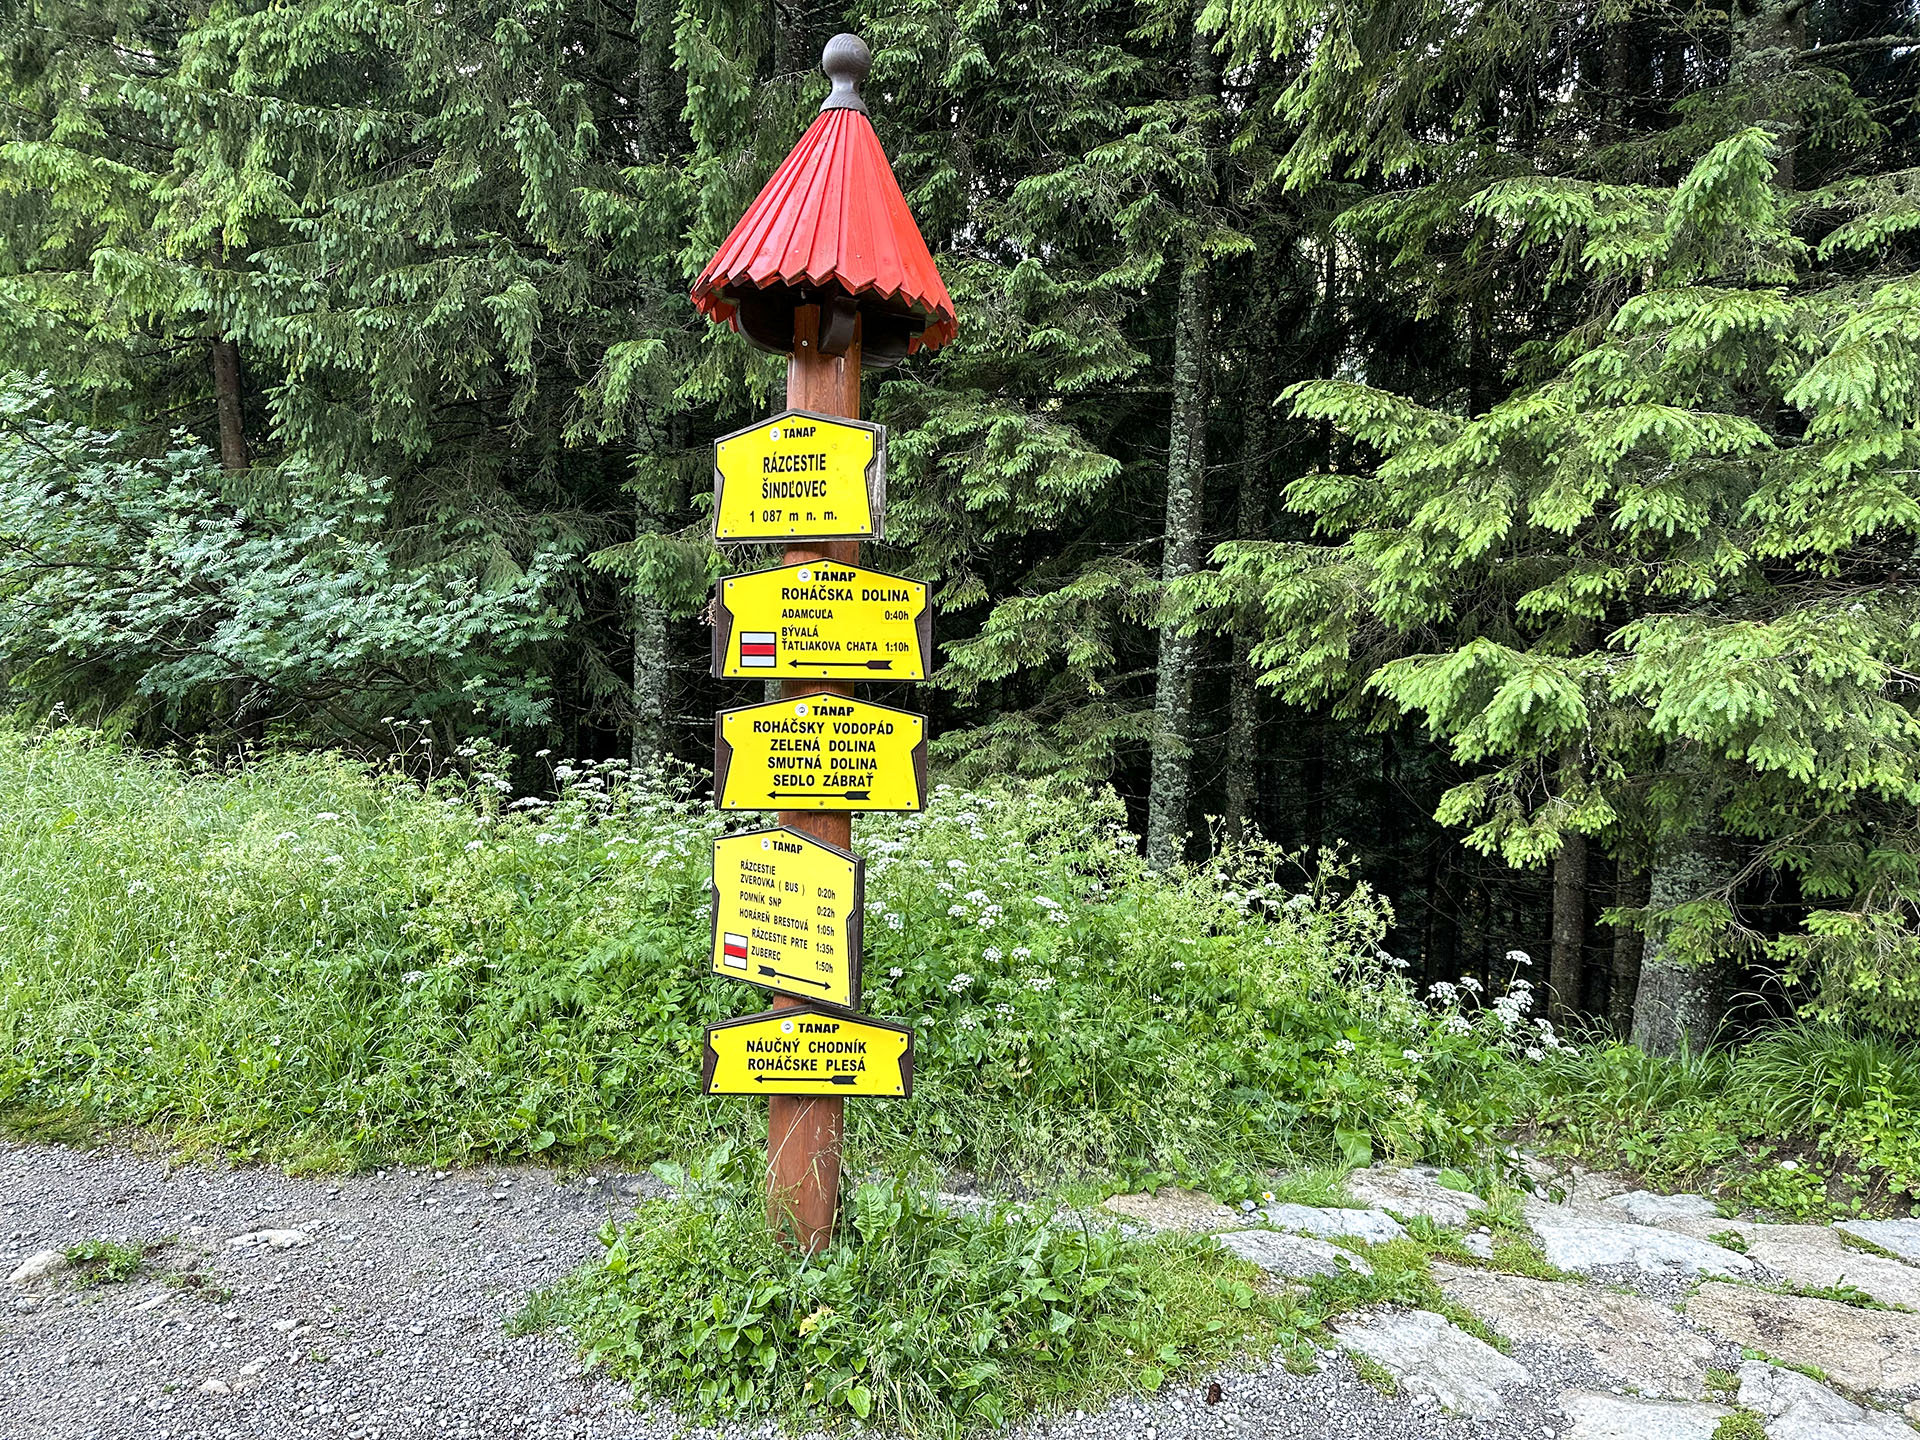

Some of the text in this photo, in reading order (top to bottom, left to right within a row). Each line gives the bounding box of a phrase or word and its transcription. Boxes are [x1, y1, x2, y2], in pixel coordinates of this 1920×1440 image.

[783, 427, 816, 439] TANAP
[763, 451, 826, 473] RÁZCESTIE
[762, 478, 826, 499] ŠINDĽOVEC
[750, 510, 837, 522] 1 087 m n. m.
[814, 571, 856, 582] TANAP
[782, 585, 910, 602] ROHÁČSKA DOLINA
[782, 609, 909, 620] ADAMCUĽA 0:40h
[782, 625, 819, 637] BÝVALÁ
[782, 638, 909, 652] ŤATLIAKOVA CHATA 1:10h
[813, 706, 854, 716] TANAP
[754, 718, 893, 735] ROHÁČSKY VODOPÁD
[770, 737, 876, 752] ZELENÁ DOLINA
[768, 754, 877, 770] SMUTNÁ DOLINA
[773, 772, 874, 787] SEDLO ZÁBRAŤ
[773, 841, 802, 854] TANAP
[741, 859, 775, 875] RÁZCESTIE
[740, 874, 775, 888] ZVEROVKA
[785, 882, 798, 892] BUS
[818, 888, 835, 900] 0:20h
[740, 891, 835, 918] POMNÍK SNP 0:22h
[740, 908, 834, 936] HORÁREŇ BRESTOVÁ 1:05h
[752, 928, 834, 955] RÁZCESTIE PRTE 1:35h
[751, 946, 833, 973] ZUBEREC 1:50h
[798, 1023, 840, 1033] TANAP
[747, 1037, 866, 1054] NÁUČNÝ CHODNÍK
[748, 1056, 865, 1071] ROHÁČSKE PLESÁ
